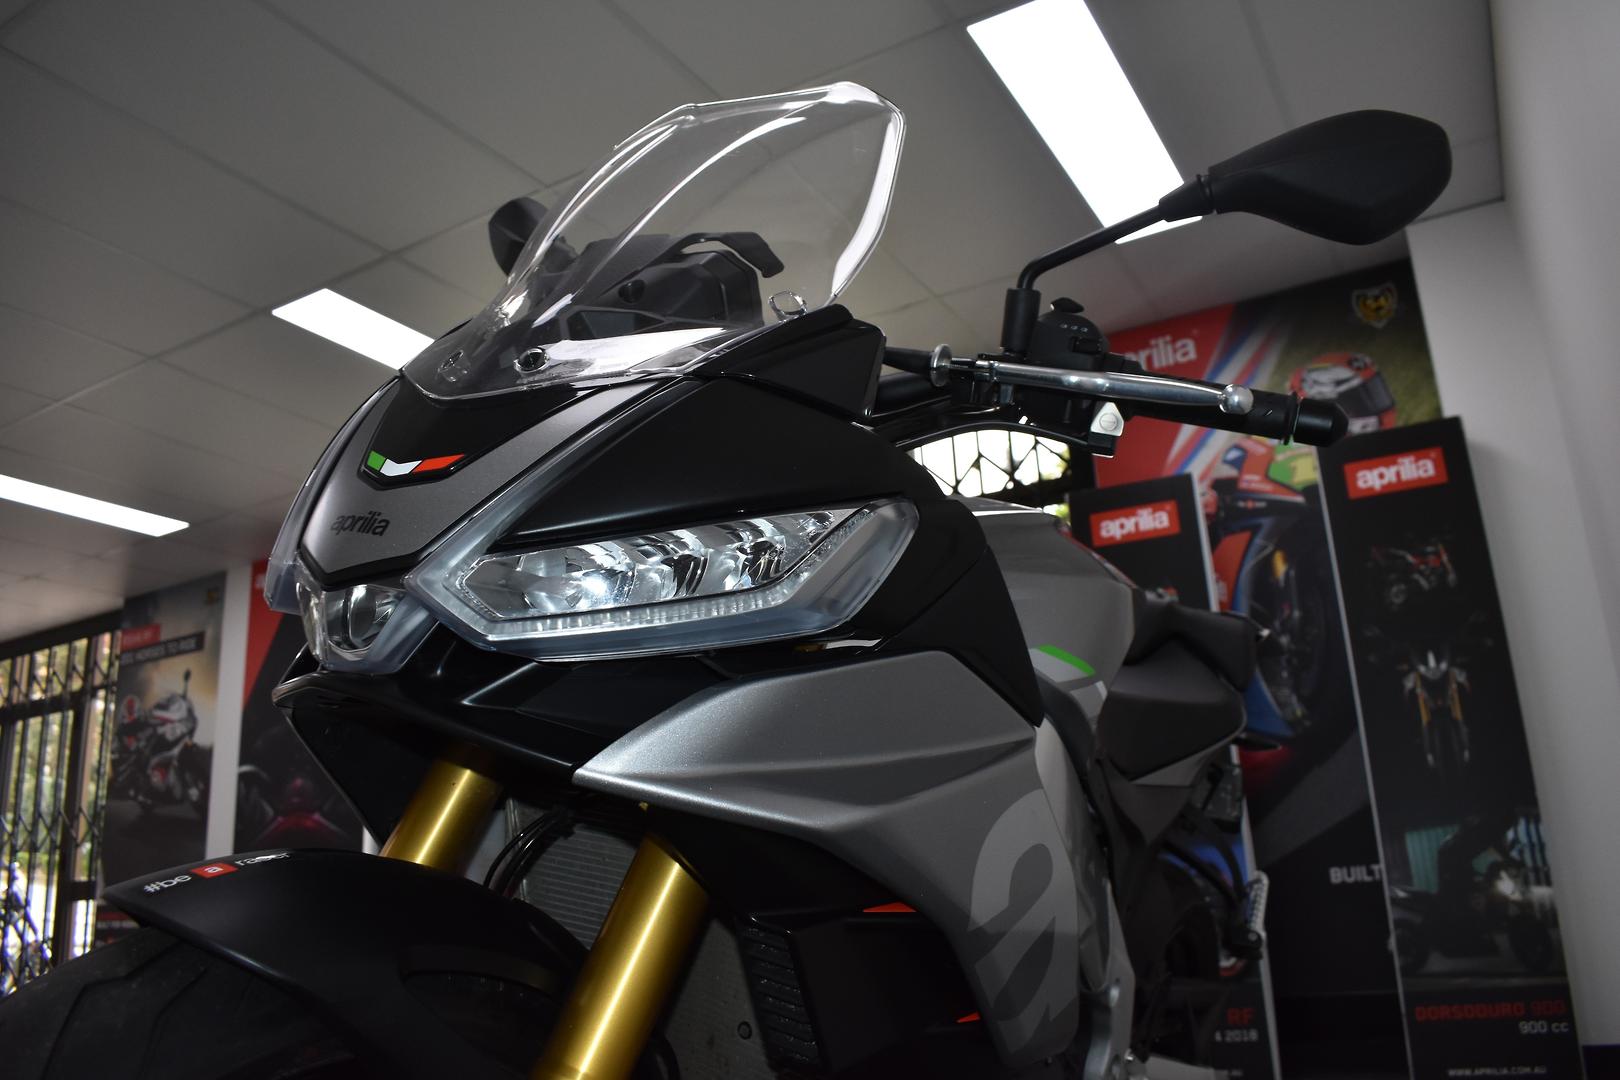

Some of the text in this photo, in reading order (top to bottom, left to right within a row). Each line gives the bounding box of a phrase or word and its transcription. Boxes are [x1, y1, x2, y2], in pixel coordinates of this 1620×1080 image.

[1125, 335, 1198, 371] rilia
[1355, 455, 1436, 491] aprilia
[330, 510, 391, 536] aprilia
[1099, 507, 1170, 540] aprilia
[143, 873, 192, 894] #be
[204, 865, 224, 874] a
[1328, 863, 1382, 885] BUILT
[1414, 999, 1568, 1021] DORSODURO 900
[1518, 1019, 1570, 1035] 900 cc
